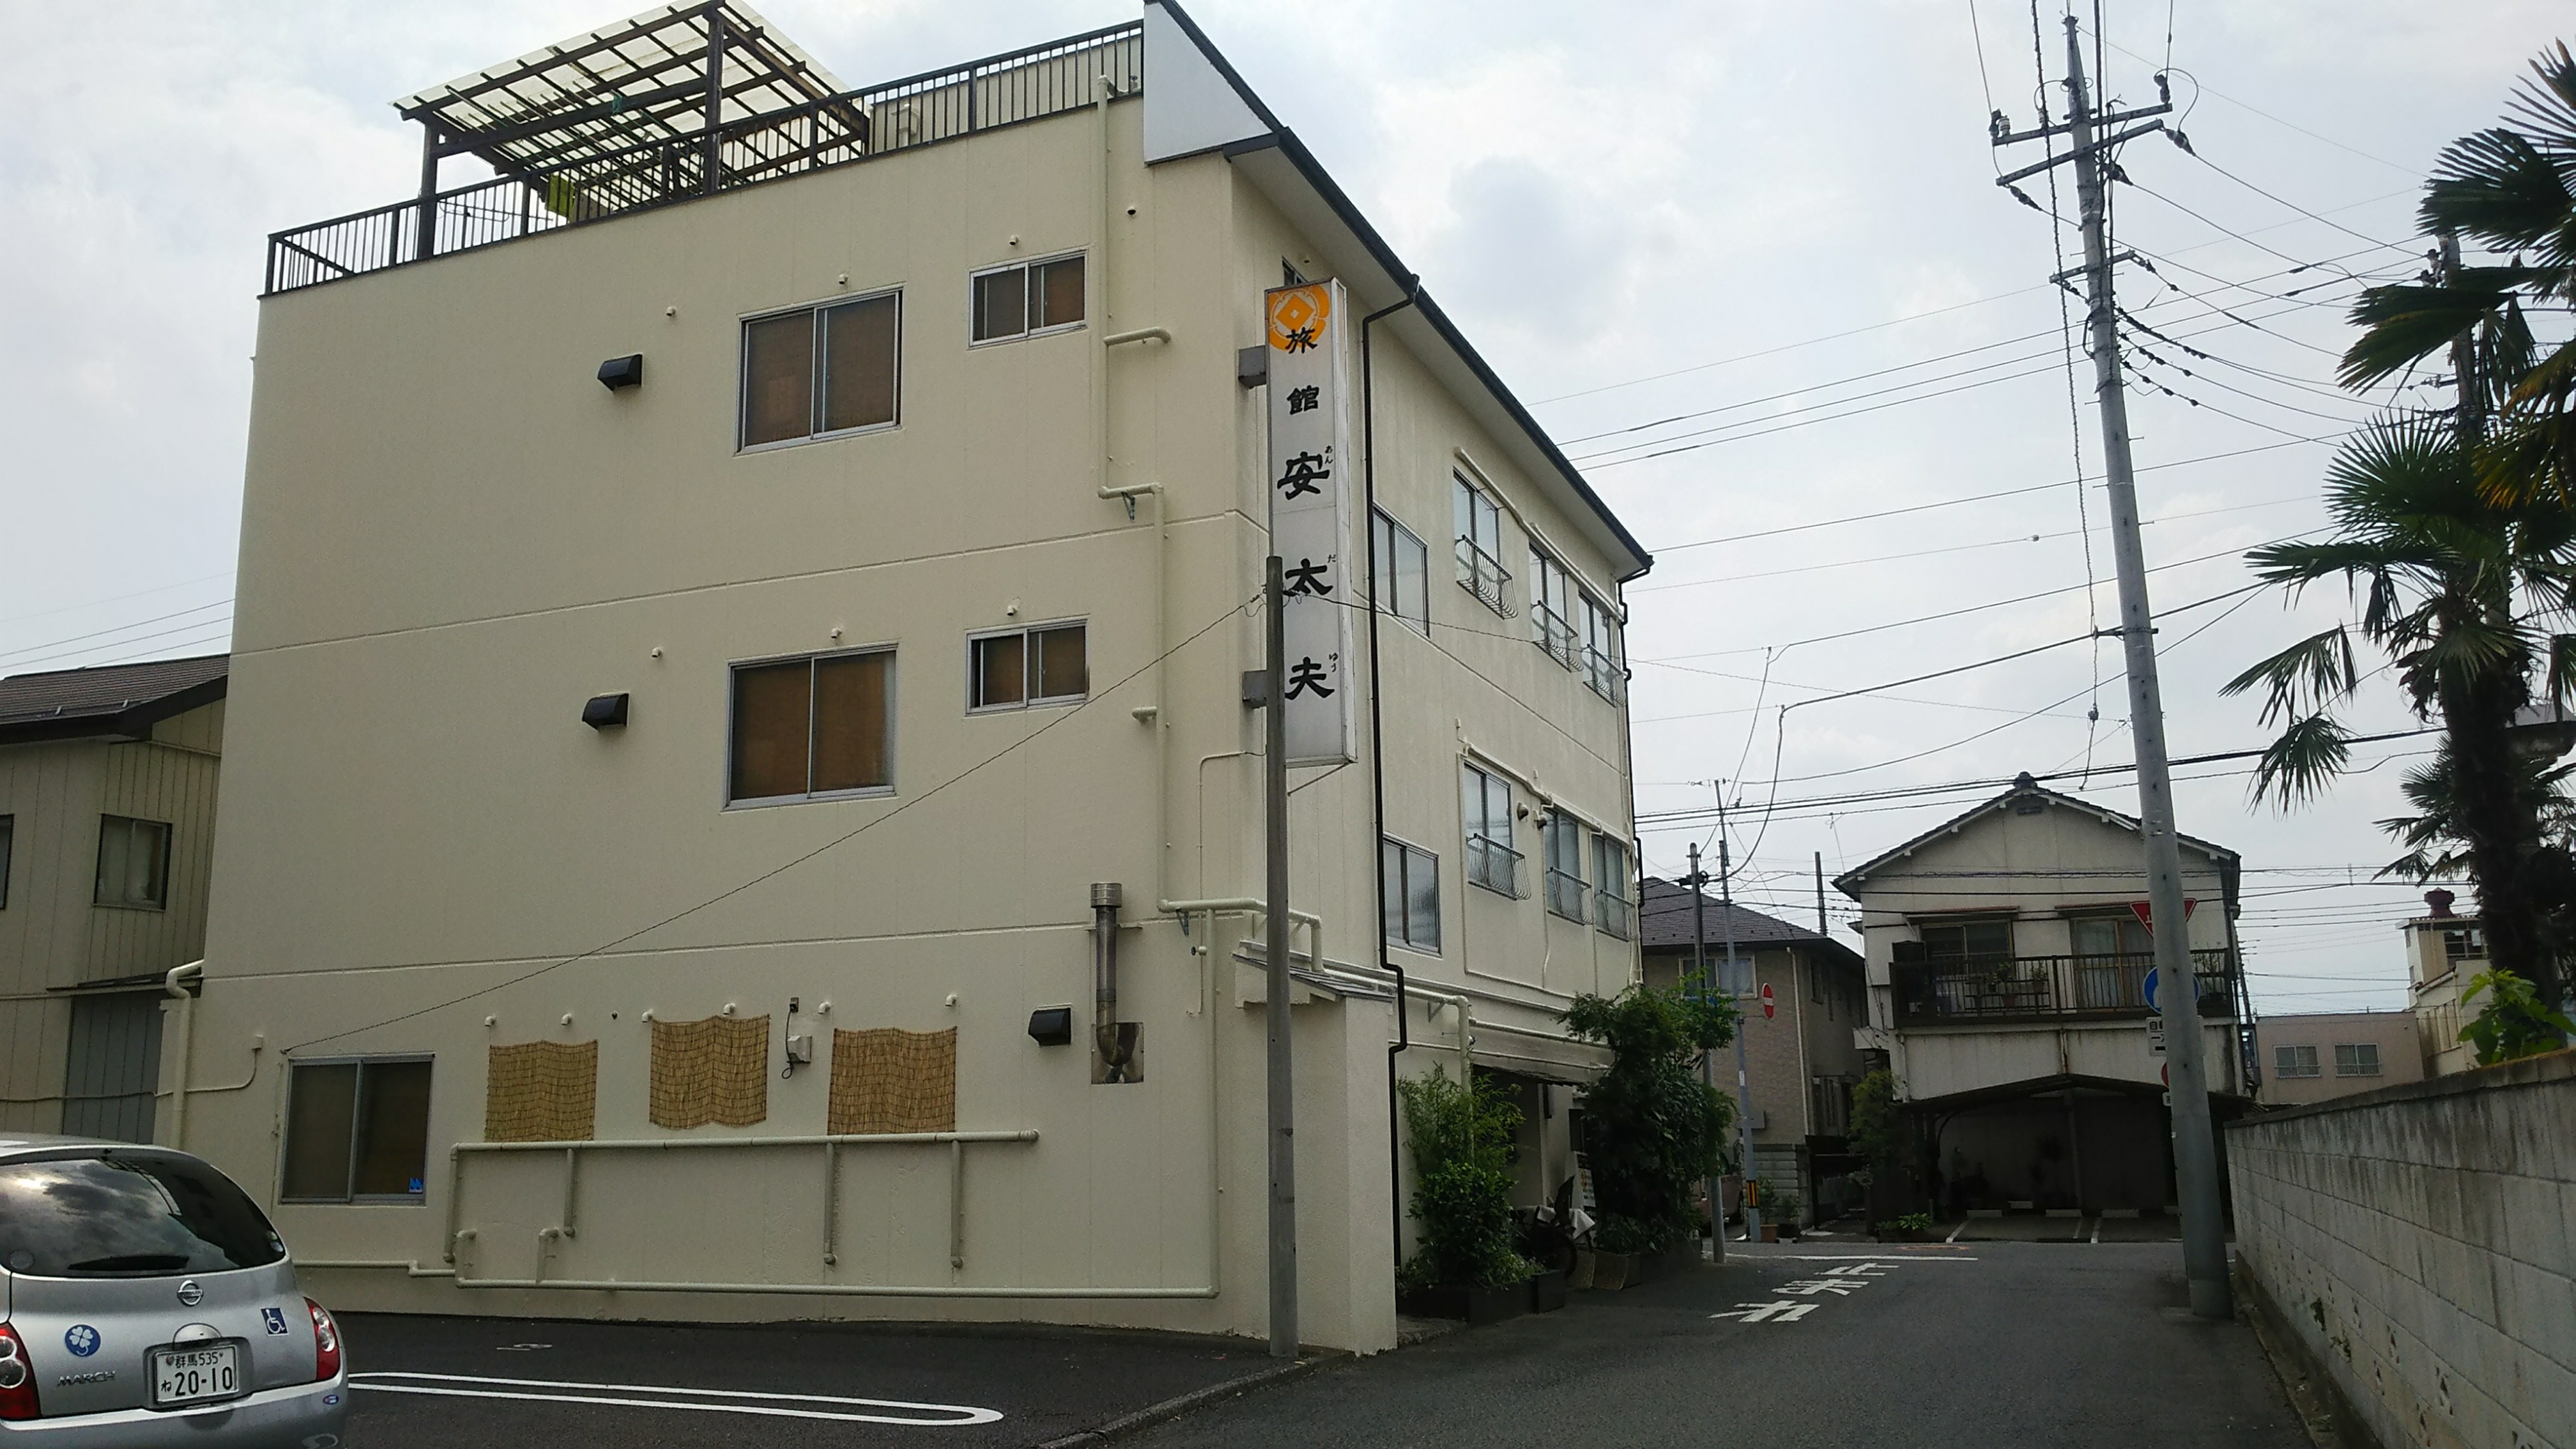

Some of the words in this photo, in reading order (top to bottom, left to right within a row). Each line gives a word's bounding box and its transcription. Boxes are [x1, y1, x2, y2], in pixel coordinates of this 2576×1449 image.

[1706, 1262, 1900, 1322] 止まれ
[57, 1371, 116, 1386] MARCH
[175, 1366, 233, 1396] 20-10
